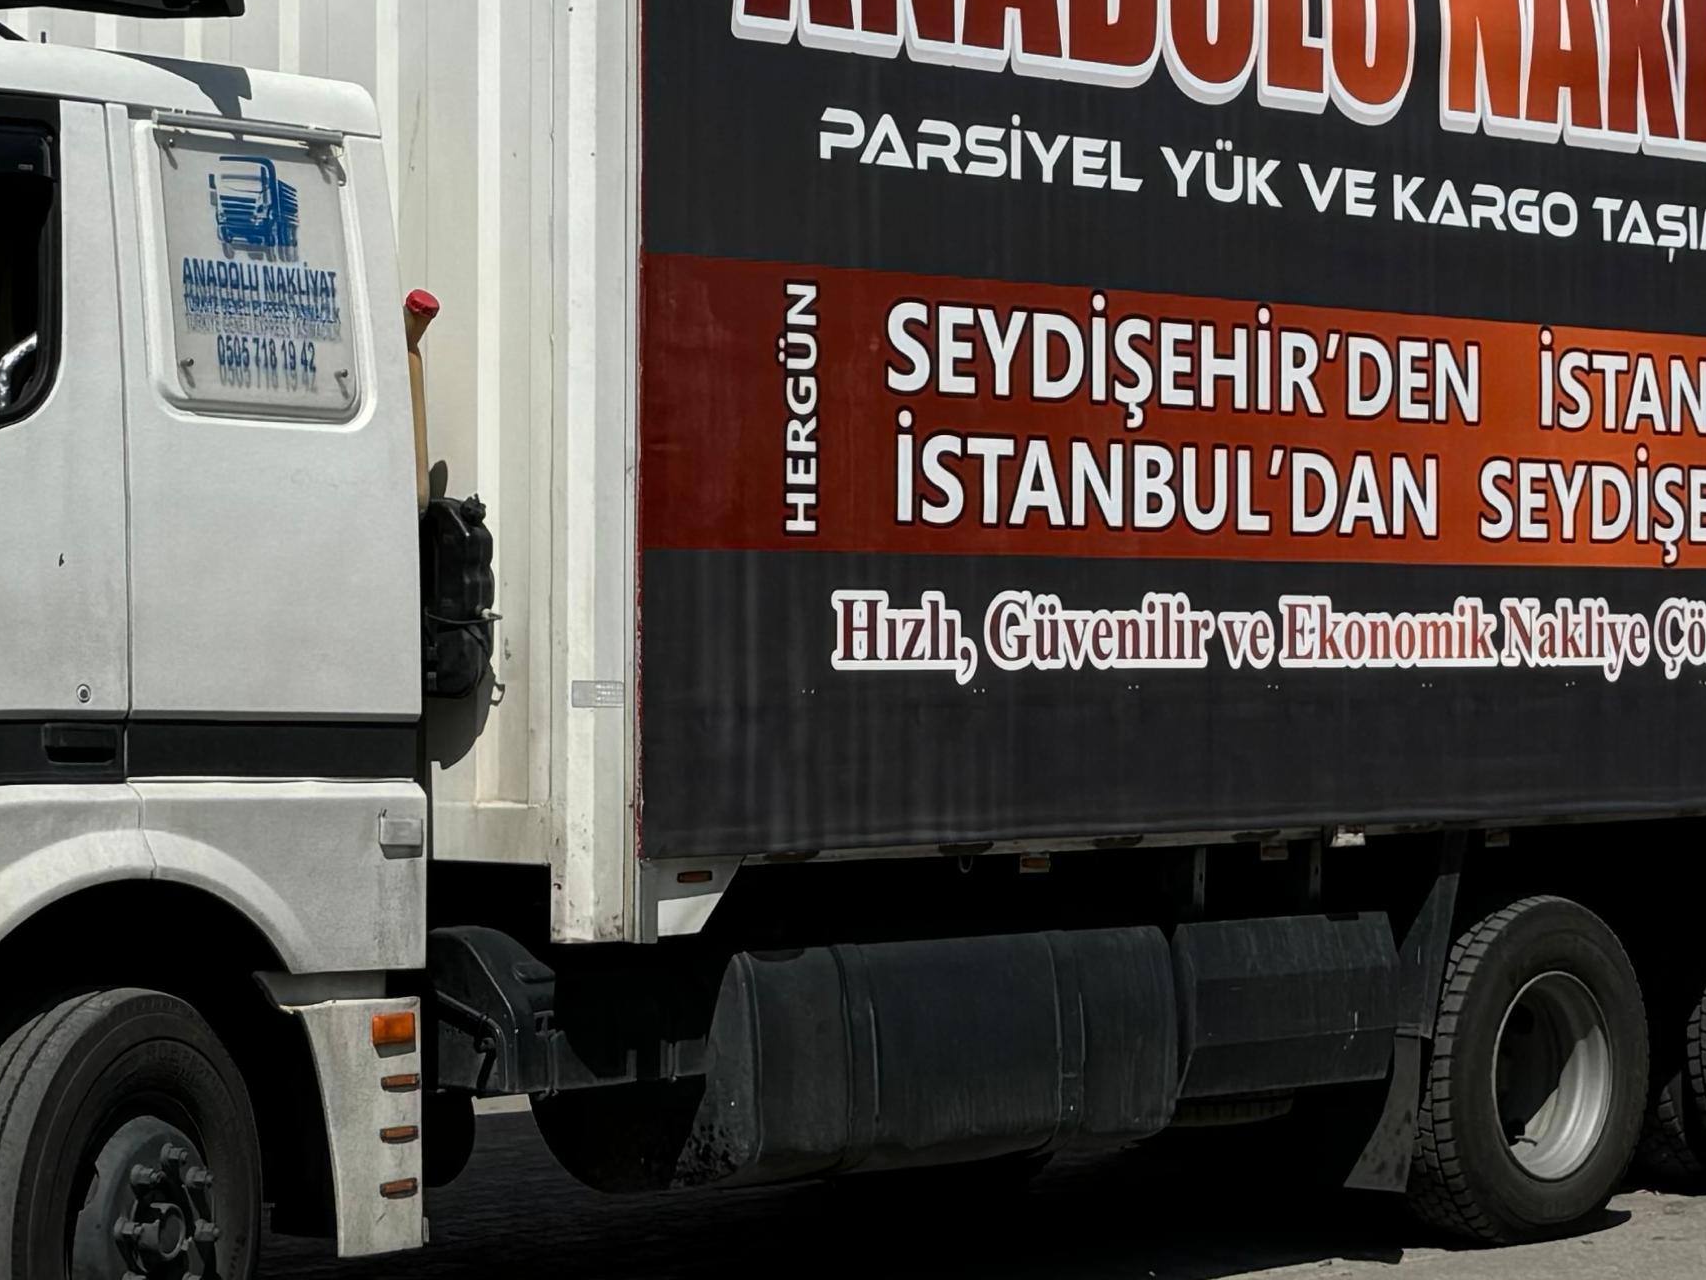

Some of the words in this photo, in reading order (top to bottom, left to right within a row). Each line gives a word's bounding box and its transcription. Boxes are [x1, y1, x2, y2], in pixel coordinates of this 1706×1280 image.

[819, 106, 1143, 193] PARSİYEL
[1159, 137, 1283, 208] YÜK
[1298, 162, 1378, 218] VE
[1393, 173, 1579, 238] KARGO
[183, 257, 259, 291] ANADOLU
[263, 262, 337, 297] NAKLİYAT
[217, 334, 250, 368] 0505
[252, 337, 278, 370] 718
[281, 340, 297, 371] 19
[300, 341, 317, 373] 42
[778, 281, 819, 534] HERGÜN
[886, 293, 1481, 431] SEYDİŞEHİR'DEN
[895, 410, 1438, 538] İSTANBUL'DAN
[832, 590, 978, 684] Hızlı,
[985, 590, 1214, 671] Güvenilir
[1218, 611, 1275, 669] ve
[1278, 594, 1497, 669] Ekonomik
[1500, 597, 1647, 682] Nakliye
